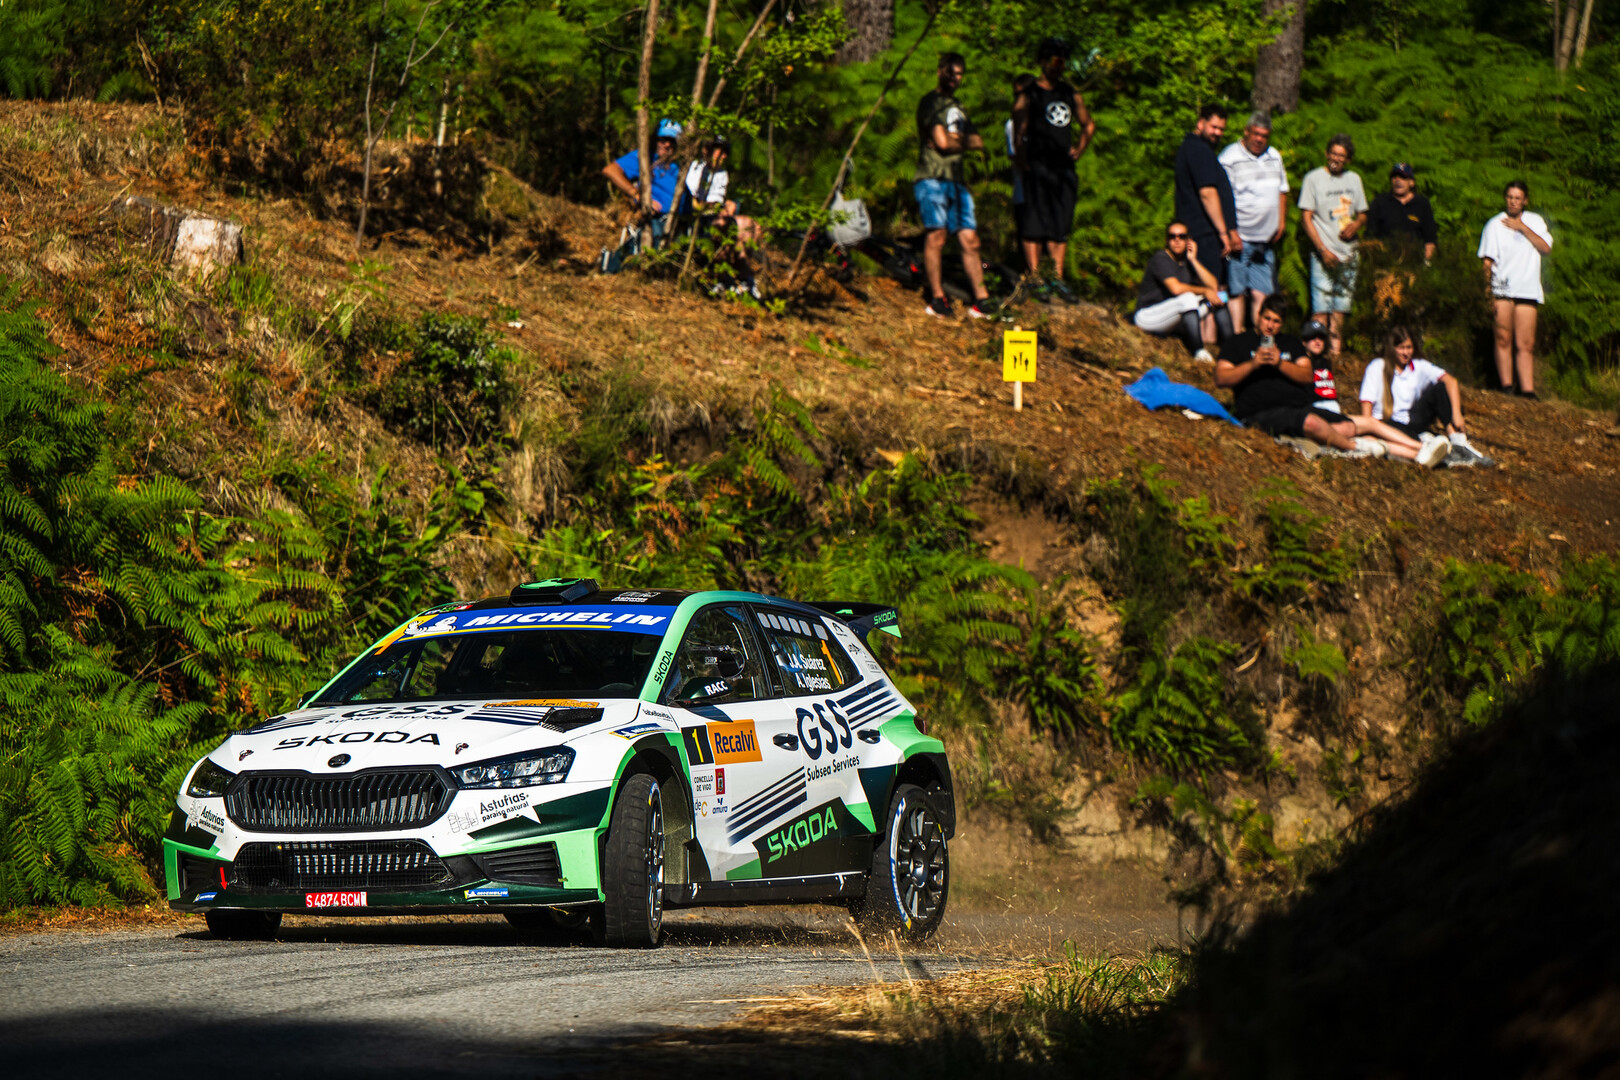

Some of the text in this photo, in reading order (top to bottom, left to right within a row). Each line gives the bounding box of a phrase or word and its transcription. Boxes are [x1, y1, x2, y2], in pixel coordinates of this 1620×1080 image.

[463, 612, 667, 627] MICHELIN
[874, 610, 897, 625] SKODA
[654, 650, 674, 685] SKODA
[821, 640, 843, 685] 1
[704, 681, 728, 696] RACC
[341, 704, 476, 718] GSS
[796, 699, 853, 760] GSS
[273, 730, 441, 751] SKODA
[691, 728, 705, 763] 1
[713, 729, 756, 754] Recalvi
[694, 774, 714, 784] CONCELLO
[806, 755, 860, 782] Subsea Services
[696, 783, 712, 792] DE VIGO
[480, 792, 526, 815] Asturias
[506, 801, 529, 813] natural
[712, 805, 728, 815] amura
[201, 805, 225, 826] Asturias
[767, 806, 838, 864] SKODA
[306, 892, 361, 908] S 4874 BCM
